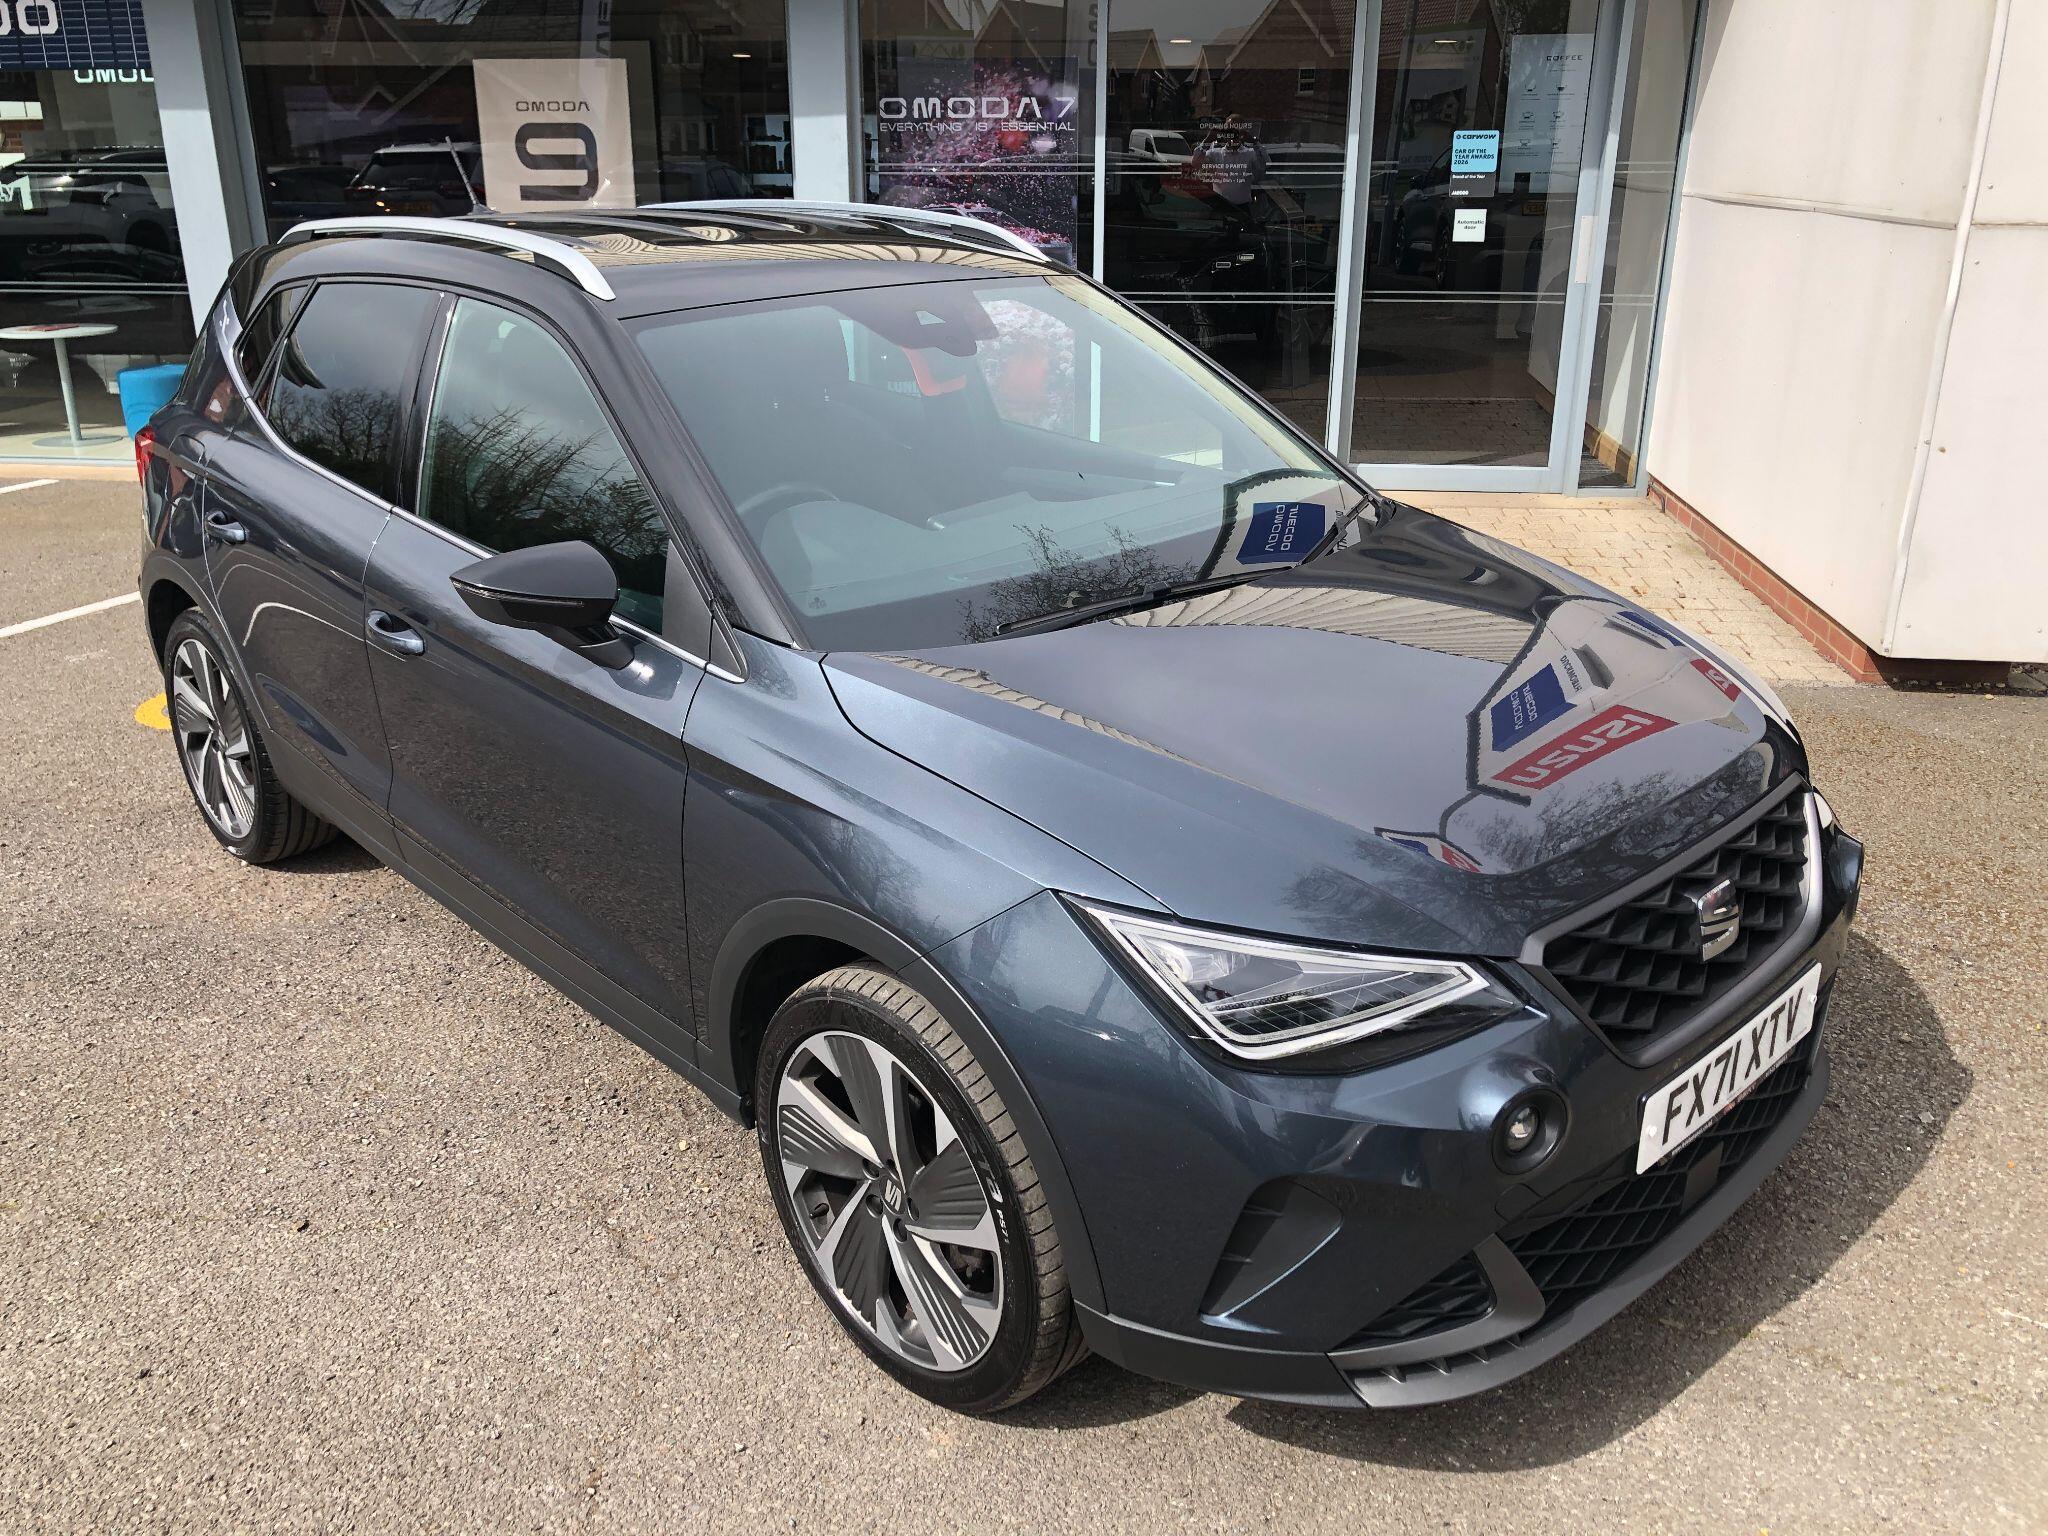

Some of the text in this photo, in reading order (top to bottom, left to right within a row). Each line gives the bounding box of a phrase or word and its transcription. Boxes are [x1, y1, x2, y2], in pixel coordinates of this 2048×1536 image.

[515, 101, 590, 112] OMODA
[879, 96, 1076, 119] OMODA 7
[880, 122, 1075, 132] EVERYTHING IS ESSENTIAL
[1199, 122, 1228, 130] OPENING
[515, 122, 600, 201] 9
[1661, 987, 1804, 1146] FX71 XTV
